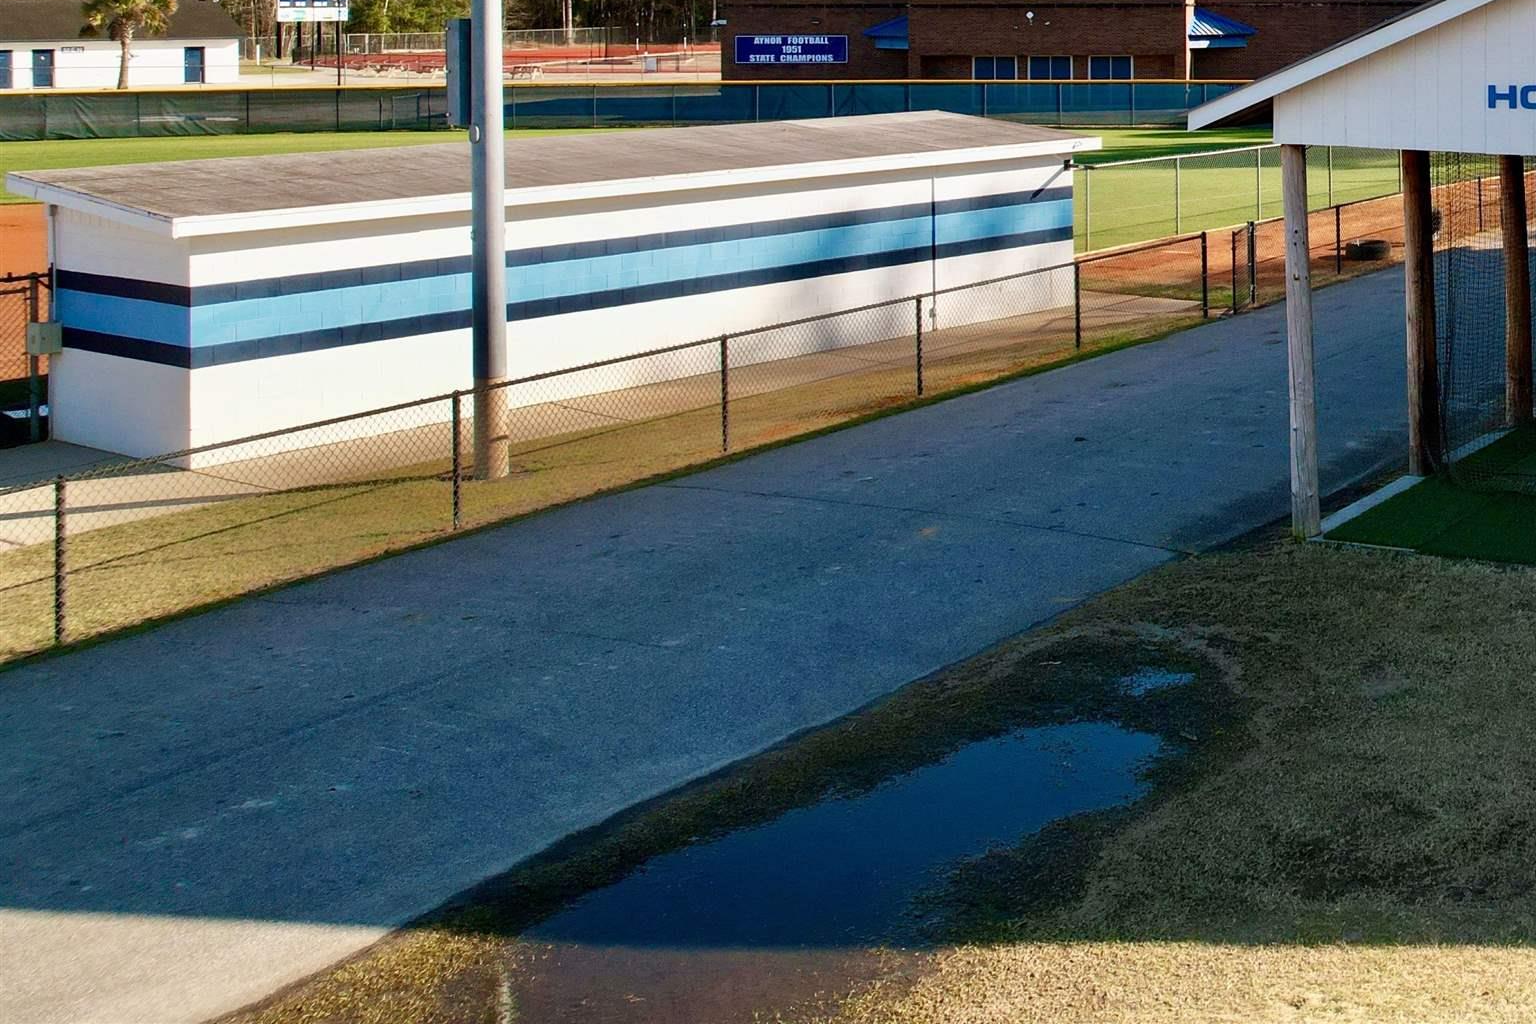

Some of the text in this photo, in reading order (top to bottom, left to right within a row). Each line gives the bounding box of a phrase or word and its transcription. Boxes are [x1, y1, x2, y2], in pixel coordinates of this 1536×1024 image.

[753, 36, 829, 45] AYNOR FOOTBALL
[781, 45, 802, 54] 1951
[749, 54, 834, 62] STATE CHAMPIONS
